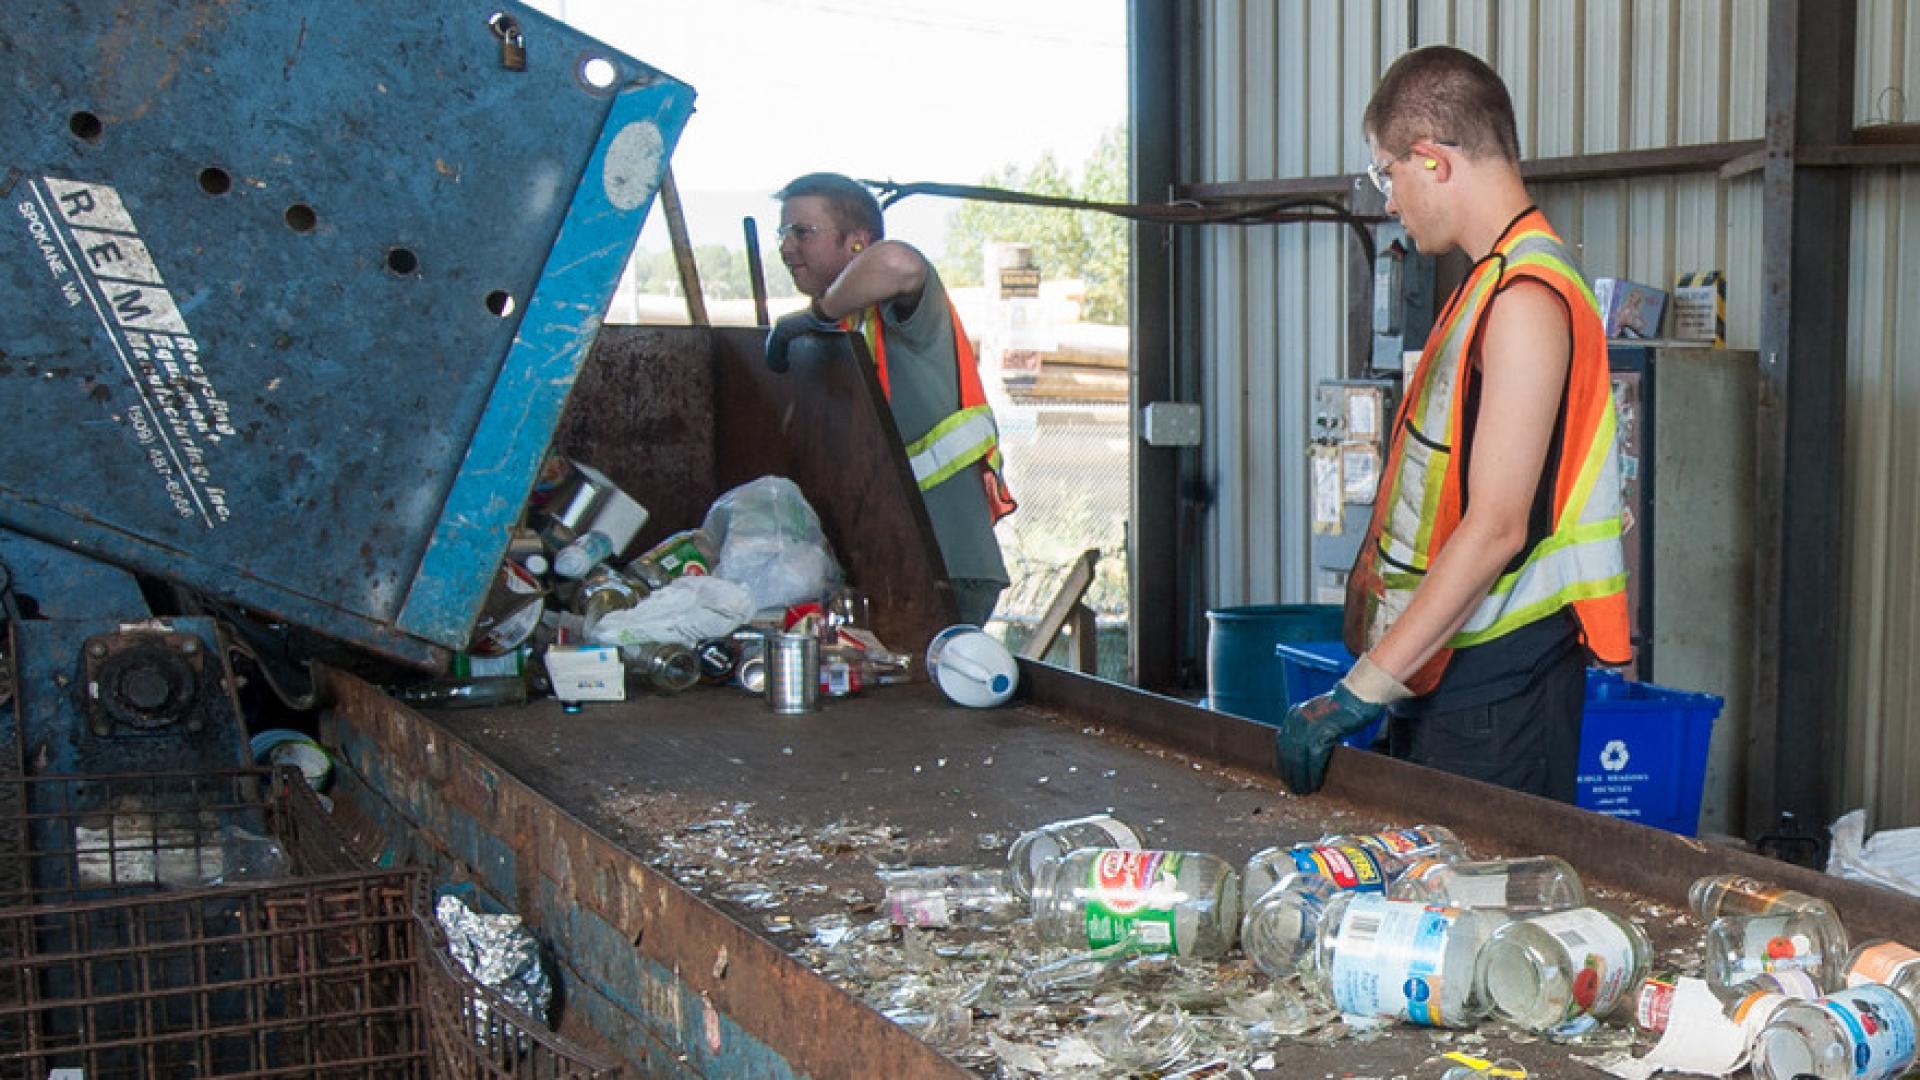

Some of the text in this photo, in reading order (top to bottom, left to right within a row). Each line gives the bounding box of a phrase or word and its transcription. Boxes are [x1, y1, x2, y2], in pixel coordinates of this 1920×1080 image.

[61, 281, 82, 306] WA
[173, 336, 237, 434] Recycling
[205, 486, 230, 522] Inc.
